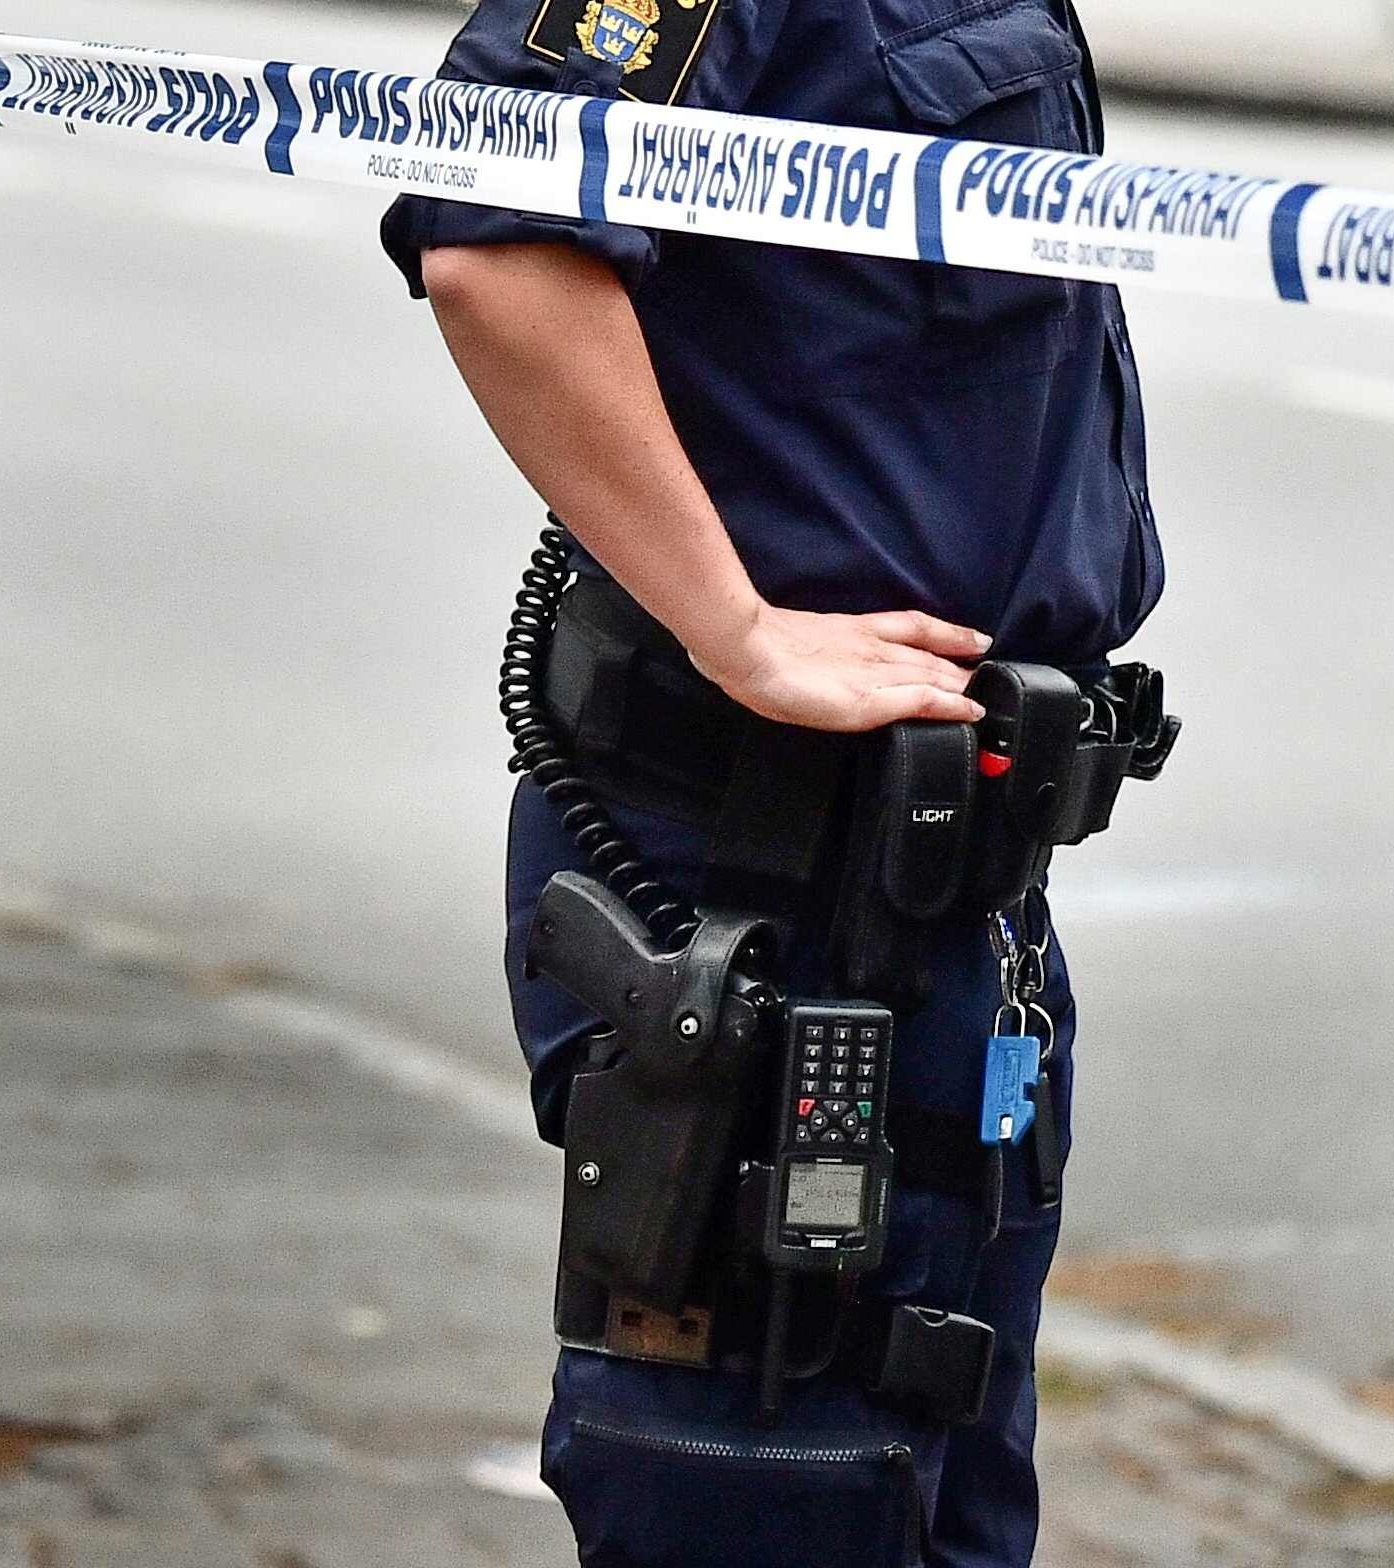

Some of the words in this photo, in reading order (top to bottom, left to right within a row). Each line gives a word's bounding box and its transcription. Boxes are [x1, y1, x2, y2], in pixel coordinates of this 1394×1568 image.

[146, 66, 260, 145] POLIS
[309, 67, 416, 145] POLIS
[367, 154, 402, 179] POLICE
[407, 160, 423, 182] DO
[422, 162, 444, 185] NOT
[444, 164, 478, 189] CROSS
[781, 140, 902, 230] POLIS
[956, 148, 1097, 224] POLIS
[912, 809, 955, 823] LIGHT
